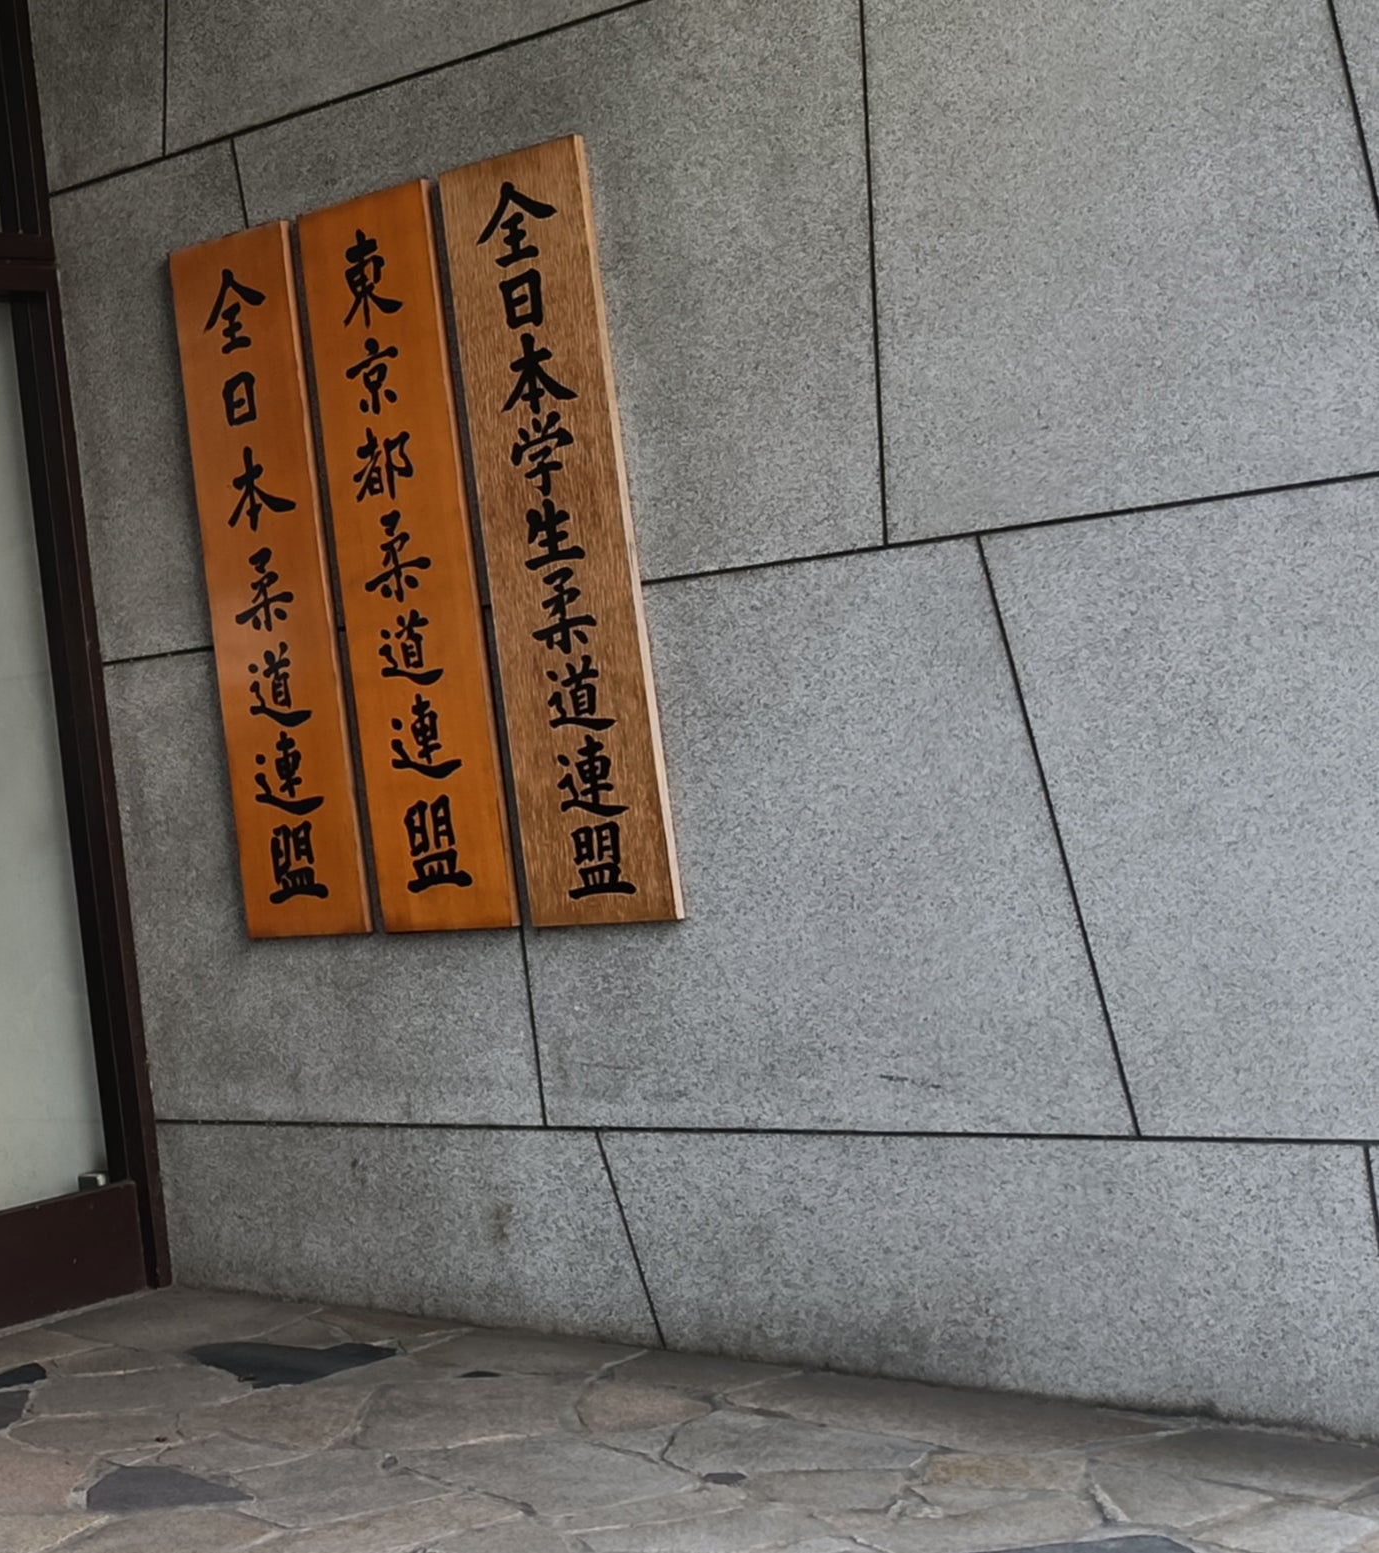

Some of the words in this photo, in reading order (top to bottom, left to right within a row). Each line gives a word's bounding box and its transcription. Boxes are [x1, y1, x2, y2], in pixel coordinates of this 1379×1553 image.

[203, 268, 329, 905] 全日本柔道連盟
[341, 228, 473, 894] 東京都柔道連盟
[477, 181, 636, 901] 全日本学生柔道連盟
